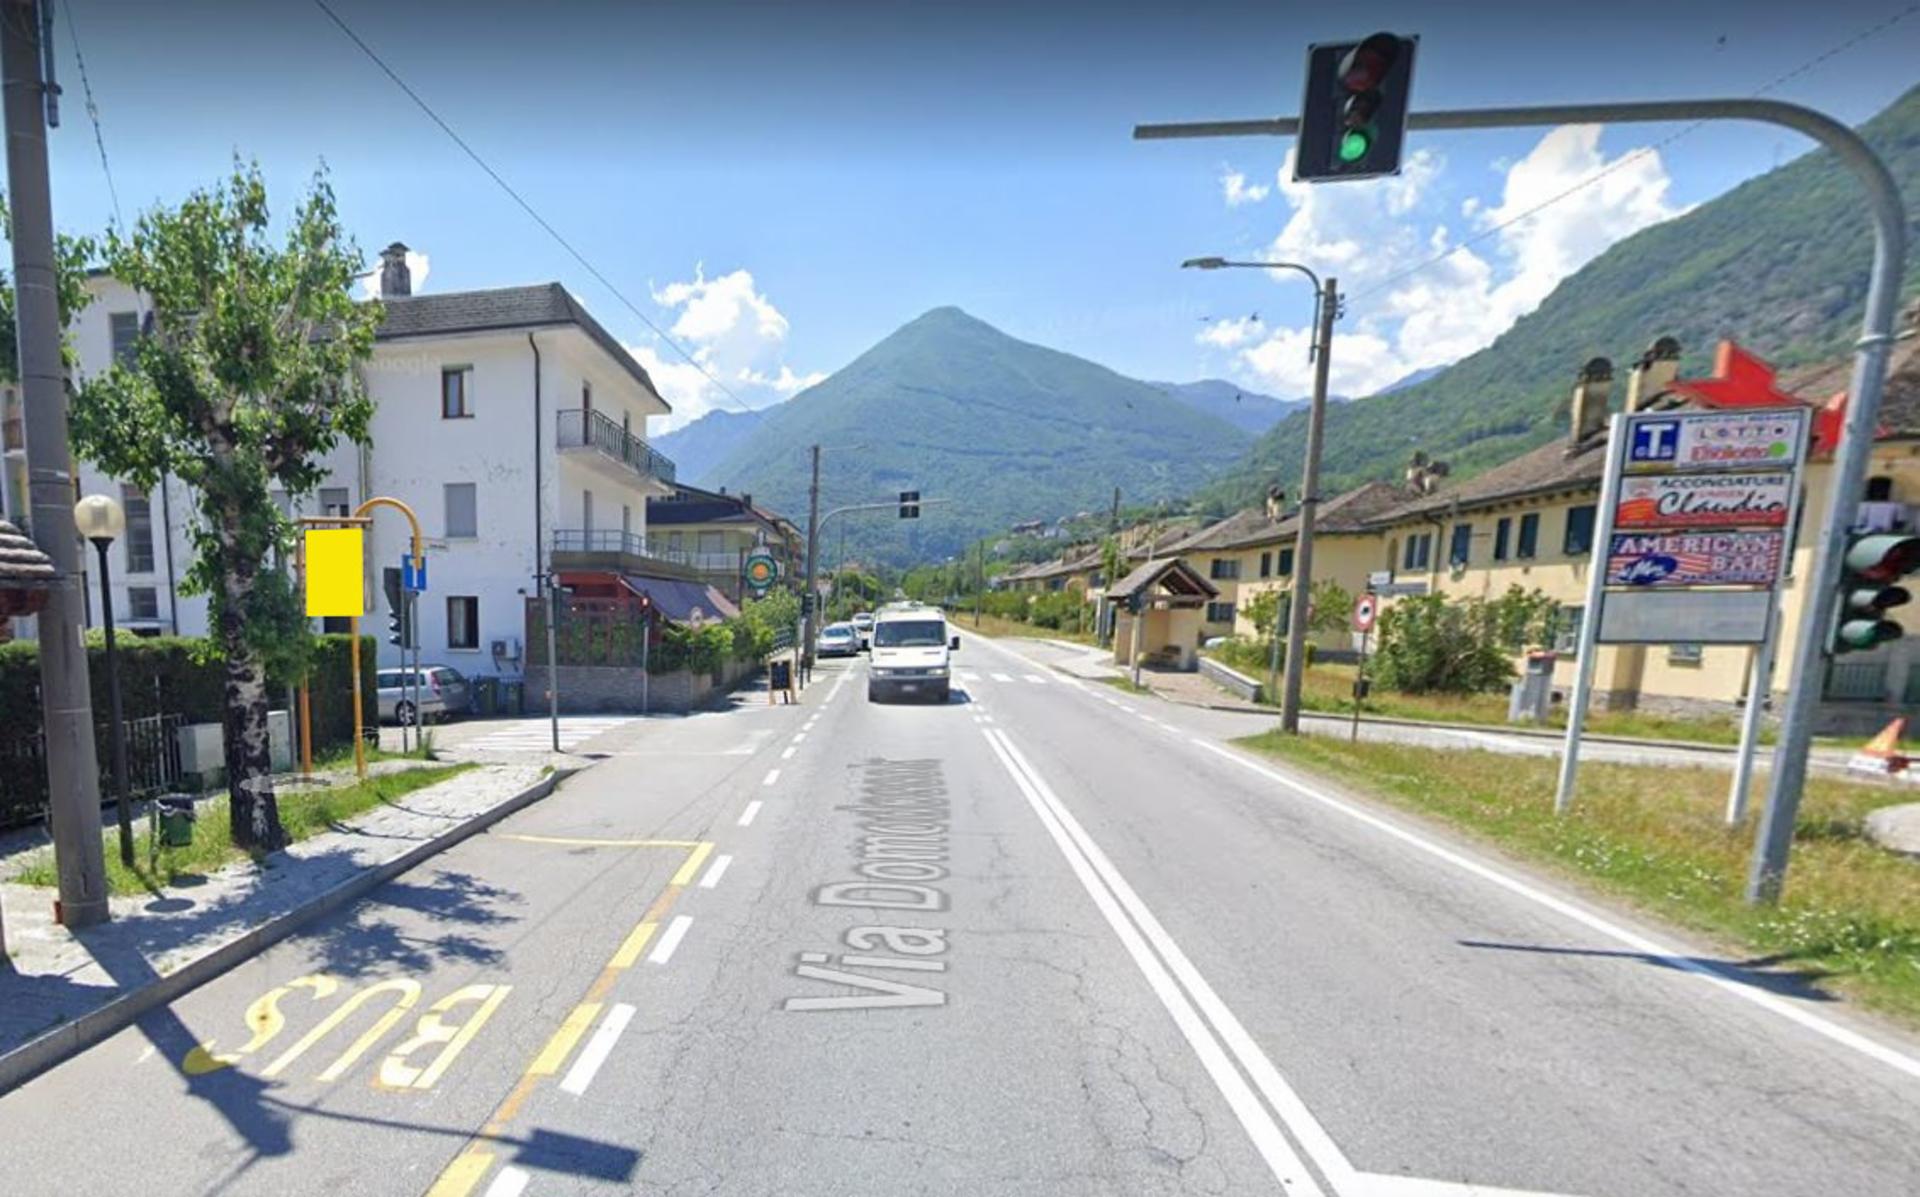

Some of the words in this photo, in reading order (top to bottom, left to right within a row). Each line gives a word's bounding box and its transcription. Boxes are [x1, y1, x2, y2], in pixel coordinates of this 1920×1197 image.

[1658, 476, 1785, 488] ACCONCIATURE
[1618, 537, 1772, 555] AMERICAN
[1710, 555, 1768, 571] BAR
[182, 974, 514, 1091] BUS
